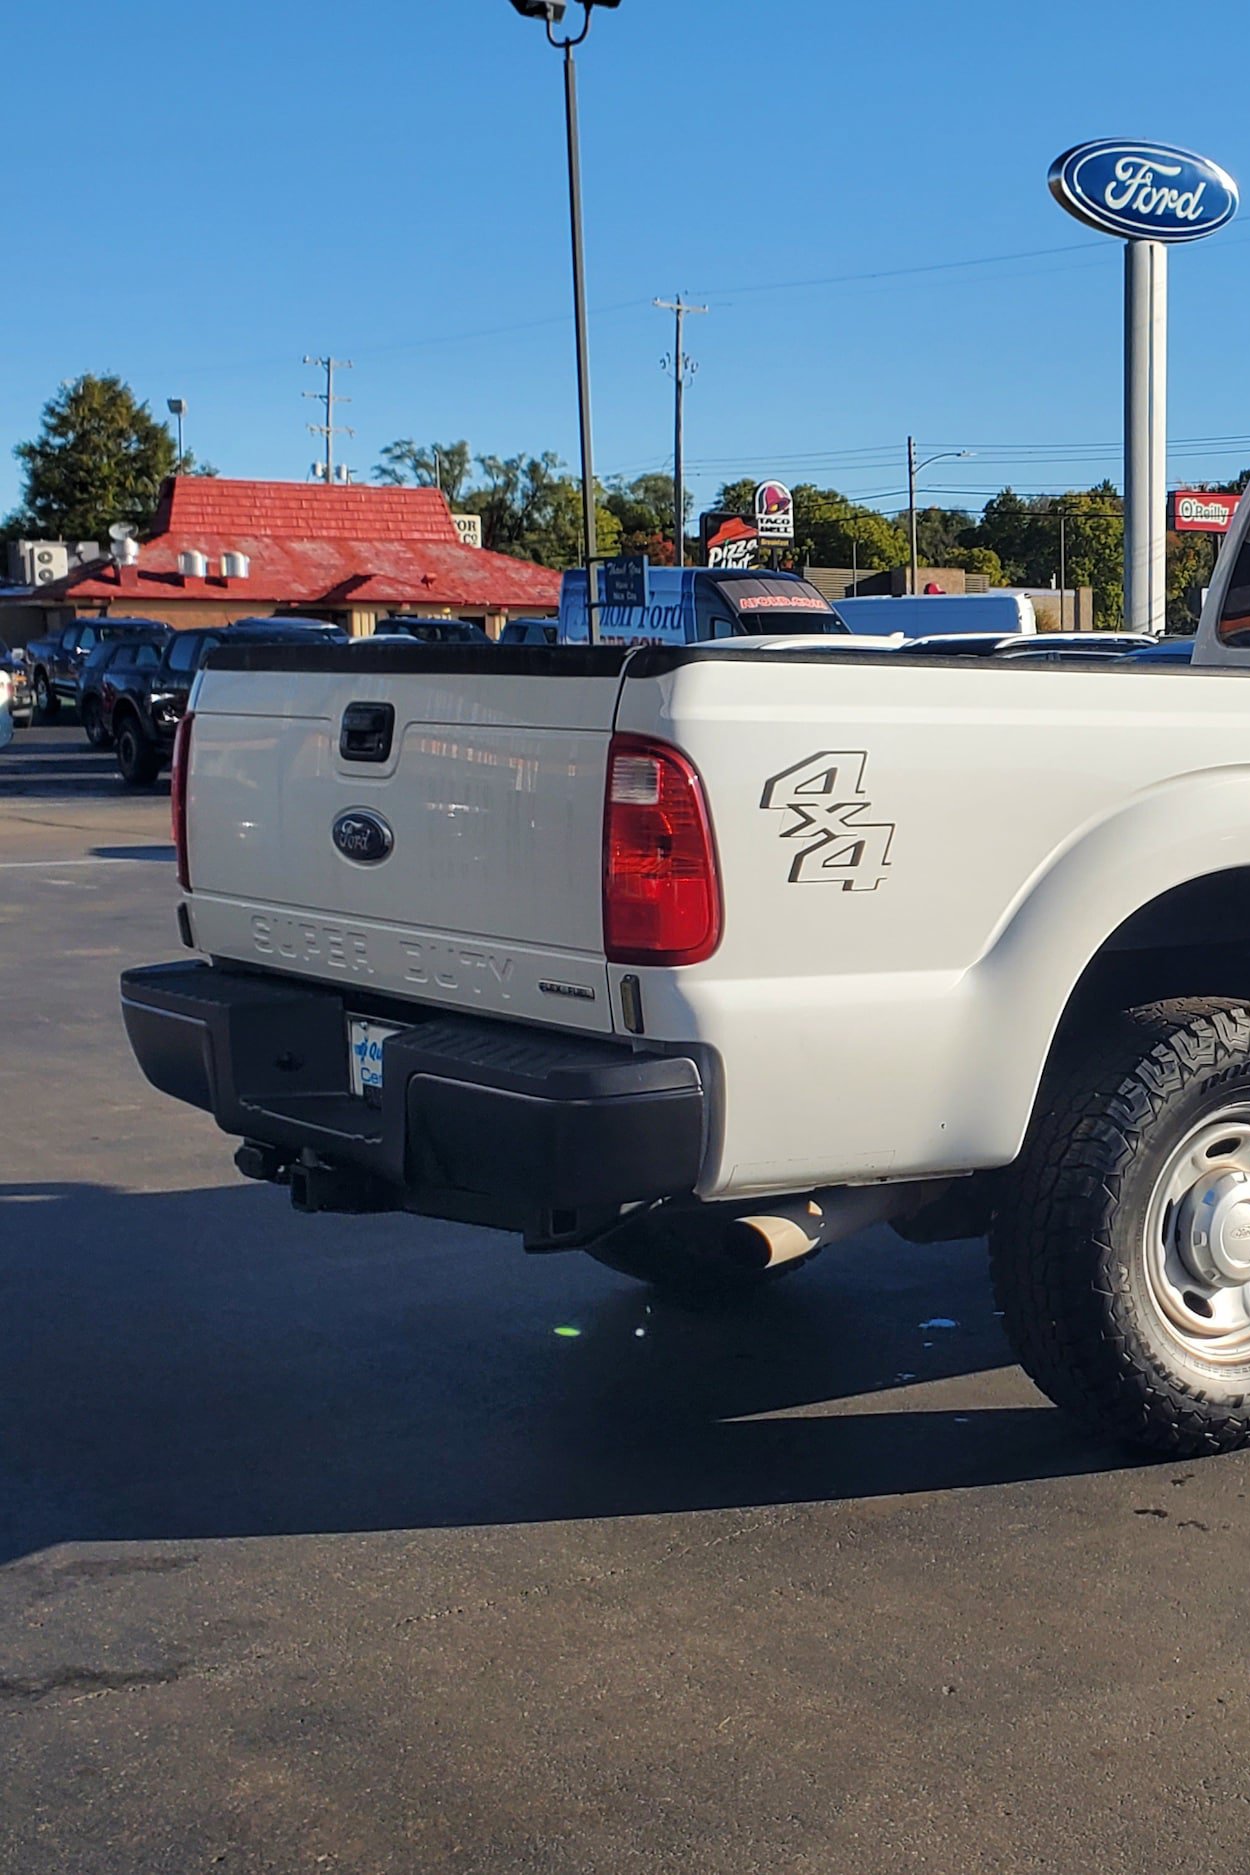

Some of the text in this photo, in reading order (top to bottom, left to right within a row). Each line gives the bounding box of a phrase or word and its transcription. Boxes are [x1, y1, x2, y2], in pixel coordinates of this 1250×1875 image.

[1104, 156, 1207, 221] Ford
[759, 517, 790, 525] TACO
[1181, 499, 1228, 523] O'Reilly
[455, 520, 476, 532] OR
[707, 539, 759, 569] Pizza
[340, 819, 371, 850] Ford
[252, 915, 516, 999] SUPER DUTY
[360, 1066, 383, 1084] Ce
